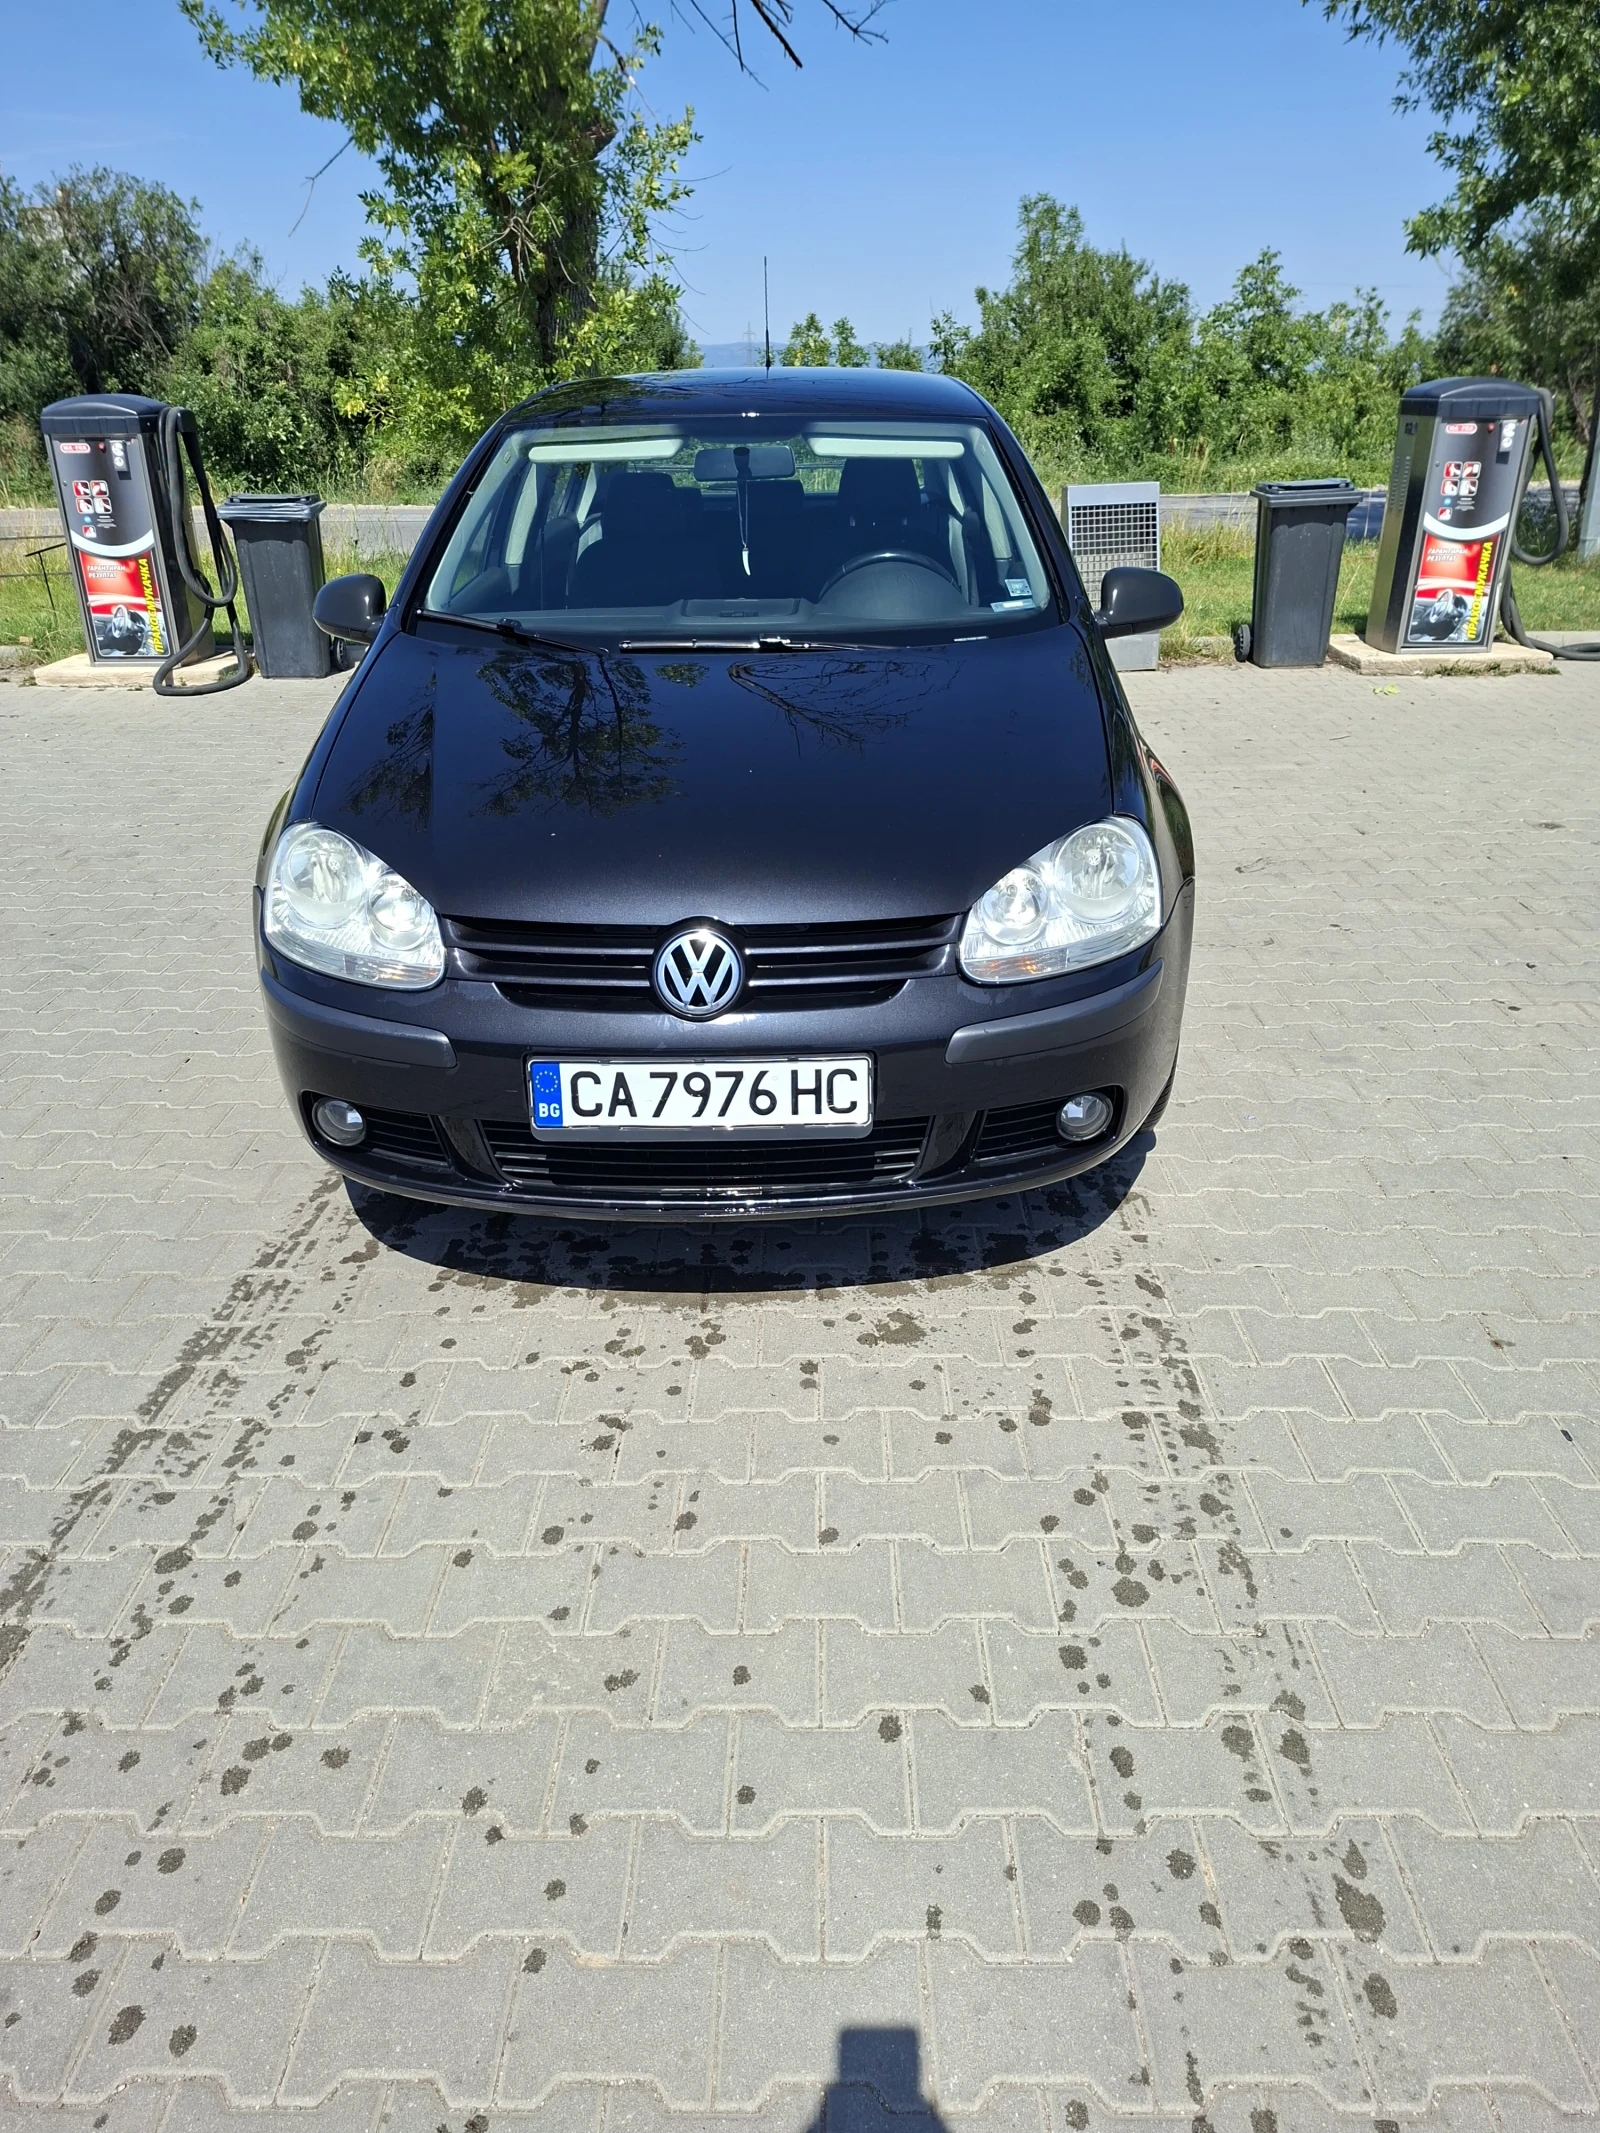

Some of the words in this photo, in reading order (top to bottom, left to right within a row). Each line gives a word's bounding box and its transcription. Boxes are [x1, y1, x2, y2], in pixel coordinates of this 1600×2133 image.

[138, 558, 165, 654] ПРАХОСМУКАЧКА
[1467, 541, 1493, 639] ПРАХОСМУКАЧКА
[660, 932, 737, 1012] VW
[538, 1102, 560, 1118] BG
